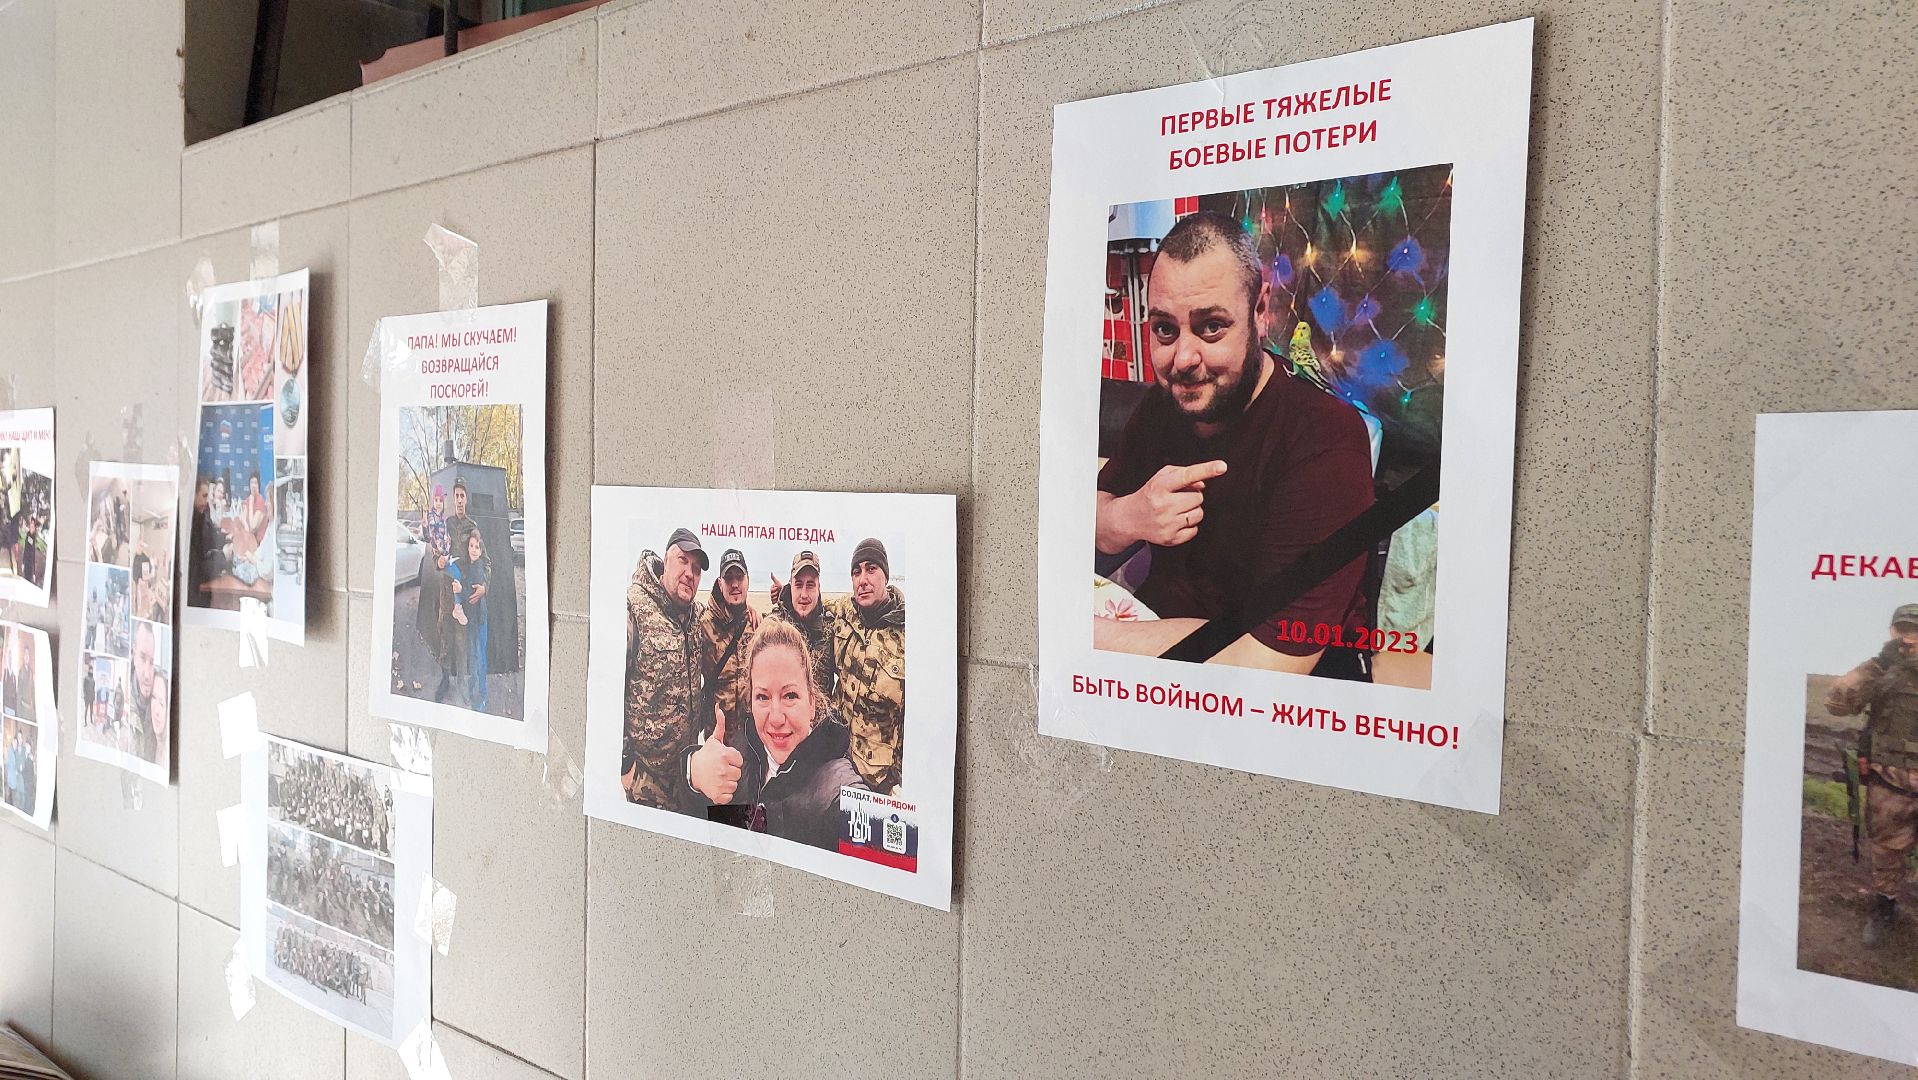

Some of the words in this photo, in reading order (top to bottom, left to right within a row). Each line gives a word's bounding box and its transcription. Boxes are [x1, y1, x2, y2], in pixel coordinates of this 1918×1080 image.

[1161, 102, 1255, 135] ПЕРВЫЕ
[1263, 79, 1392, 119] ТЯЖЕЛЫЕ
[1169, 138, 1267, 170] БОЕВЫЕ
[1274, 120, 1377, 156] ПОТЕРИ
[408, 333, 438, 350] ПАПА!
[441, 332, 460, 348] МЫ
[463, 326, 517, 346] СКУЧАЕМ!
[421, 351, 499, 374] ВОЗВРАЩАЙСЯ
[430, 377, 489, 399] ПОСКОРЕЙ!
[701, 522, 736, 539] НАША
[739, 525, 775, 541] ПЯТАЯ
[778, 526, 836, 544] ПОЕЗДКА
[1277, 619, 1418, 655] 10.01.2023
[1072, 674, 1130, 700] БЫТЬ
[1135, 683, 1244, 717] ВОЙНОМ
[1271, 702, 1347, 733] ЖИТЬ
[1355, 714, 1460, 750] ВЕЧНО!
[841, 789, 872, 804] СОЛДАТ,
[872, 796, 886, 806] МЫ
[887, 799, 916, 812] РЯДОМ!
